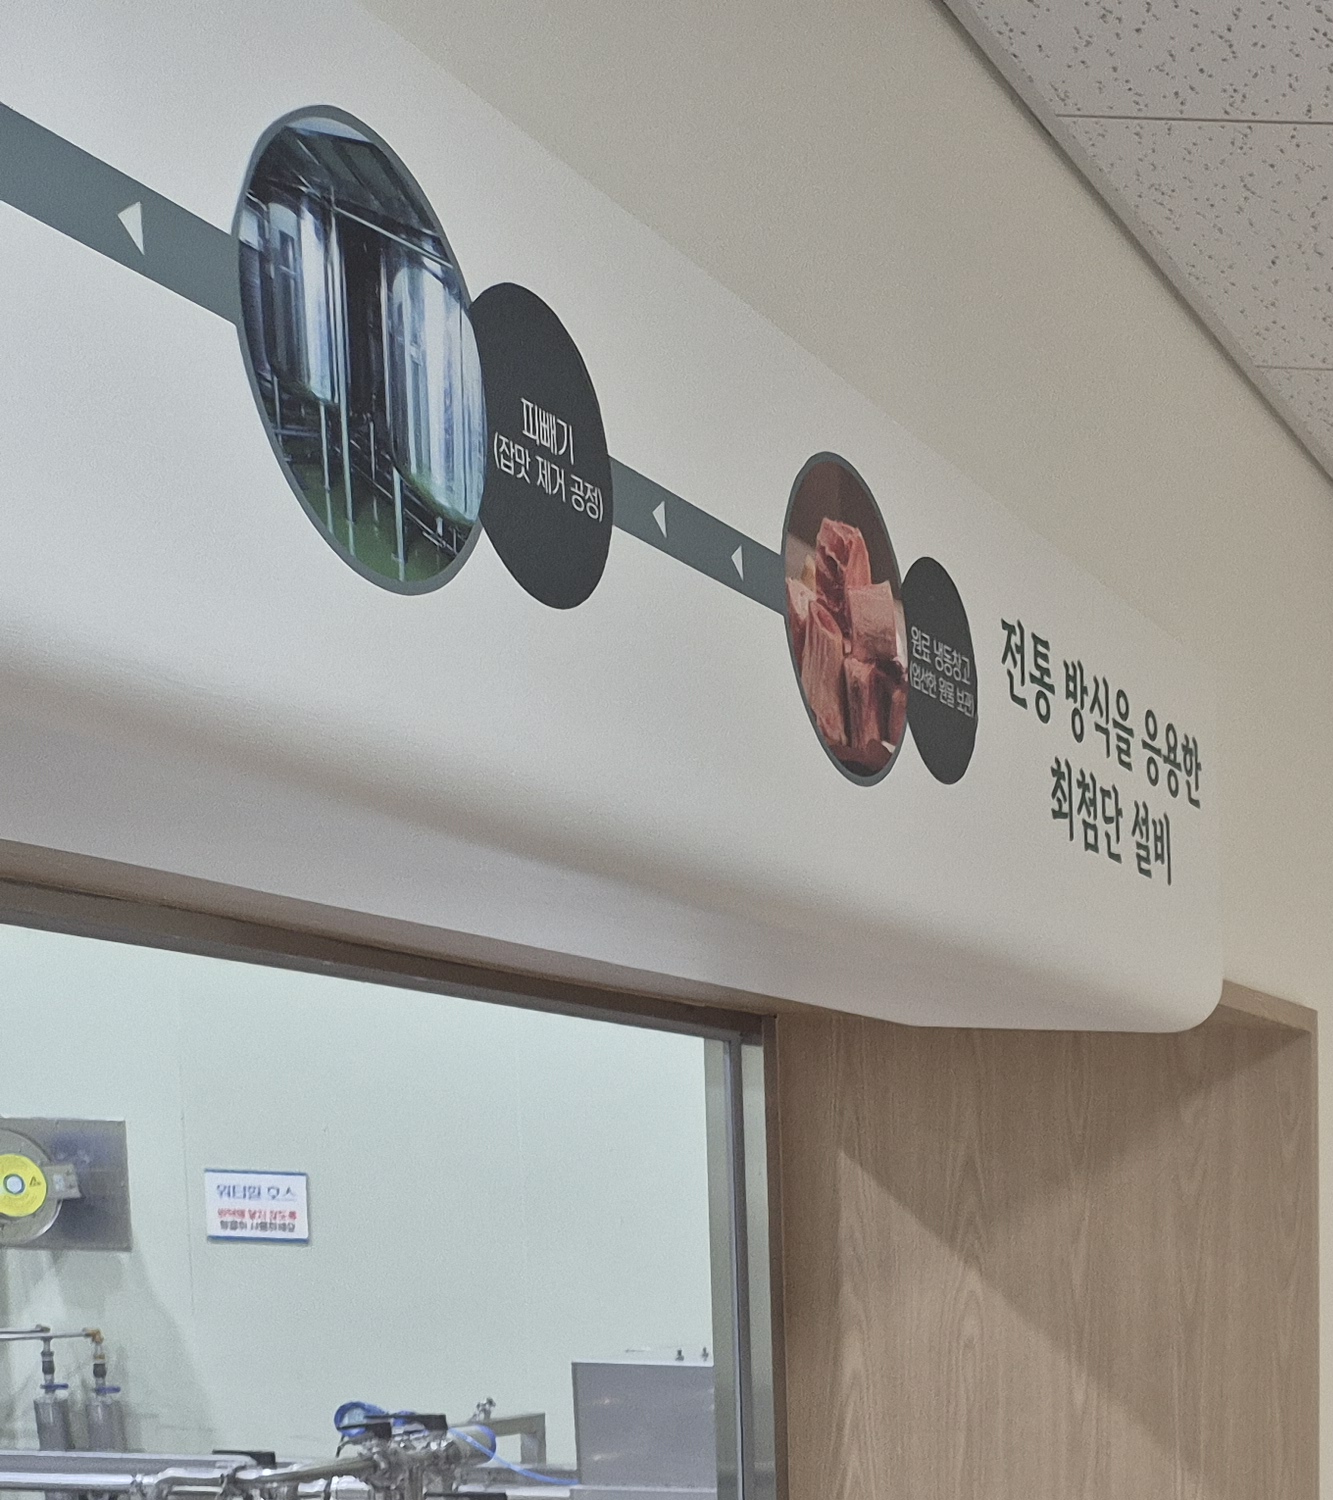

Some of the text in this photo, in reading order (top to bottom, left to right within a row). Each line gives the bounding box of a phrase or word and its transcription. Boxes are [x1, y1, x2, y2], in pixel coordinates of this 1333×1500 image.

[520, 397, 575, 465] 피빼기
[493, 431, 603, 522] (잡맛 제거 공정)
[909, 660, 937, 698] (엄선한
[911, 626, 971, 685] 원료 냉동창고
[1000, 618, 1202, 810] 전통 방식을 응용한
[1050, 756, 1172, 887] 최첨단 설비
